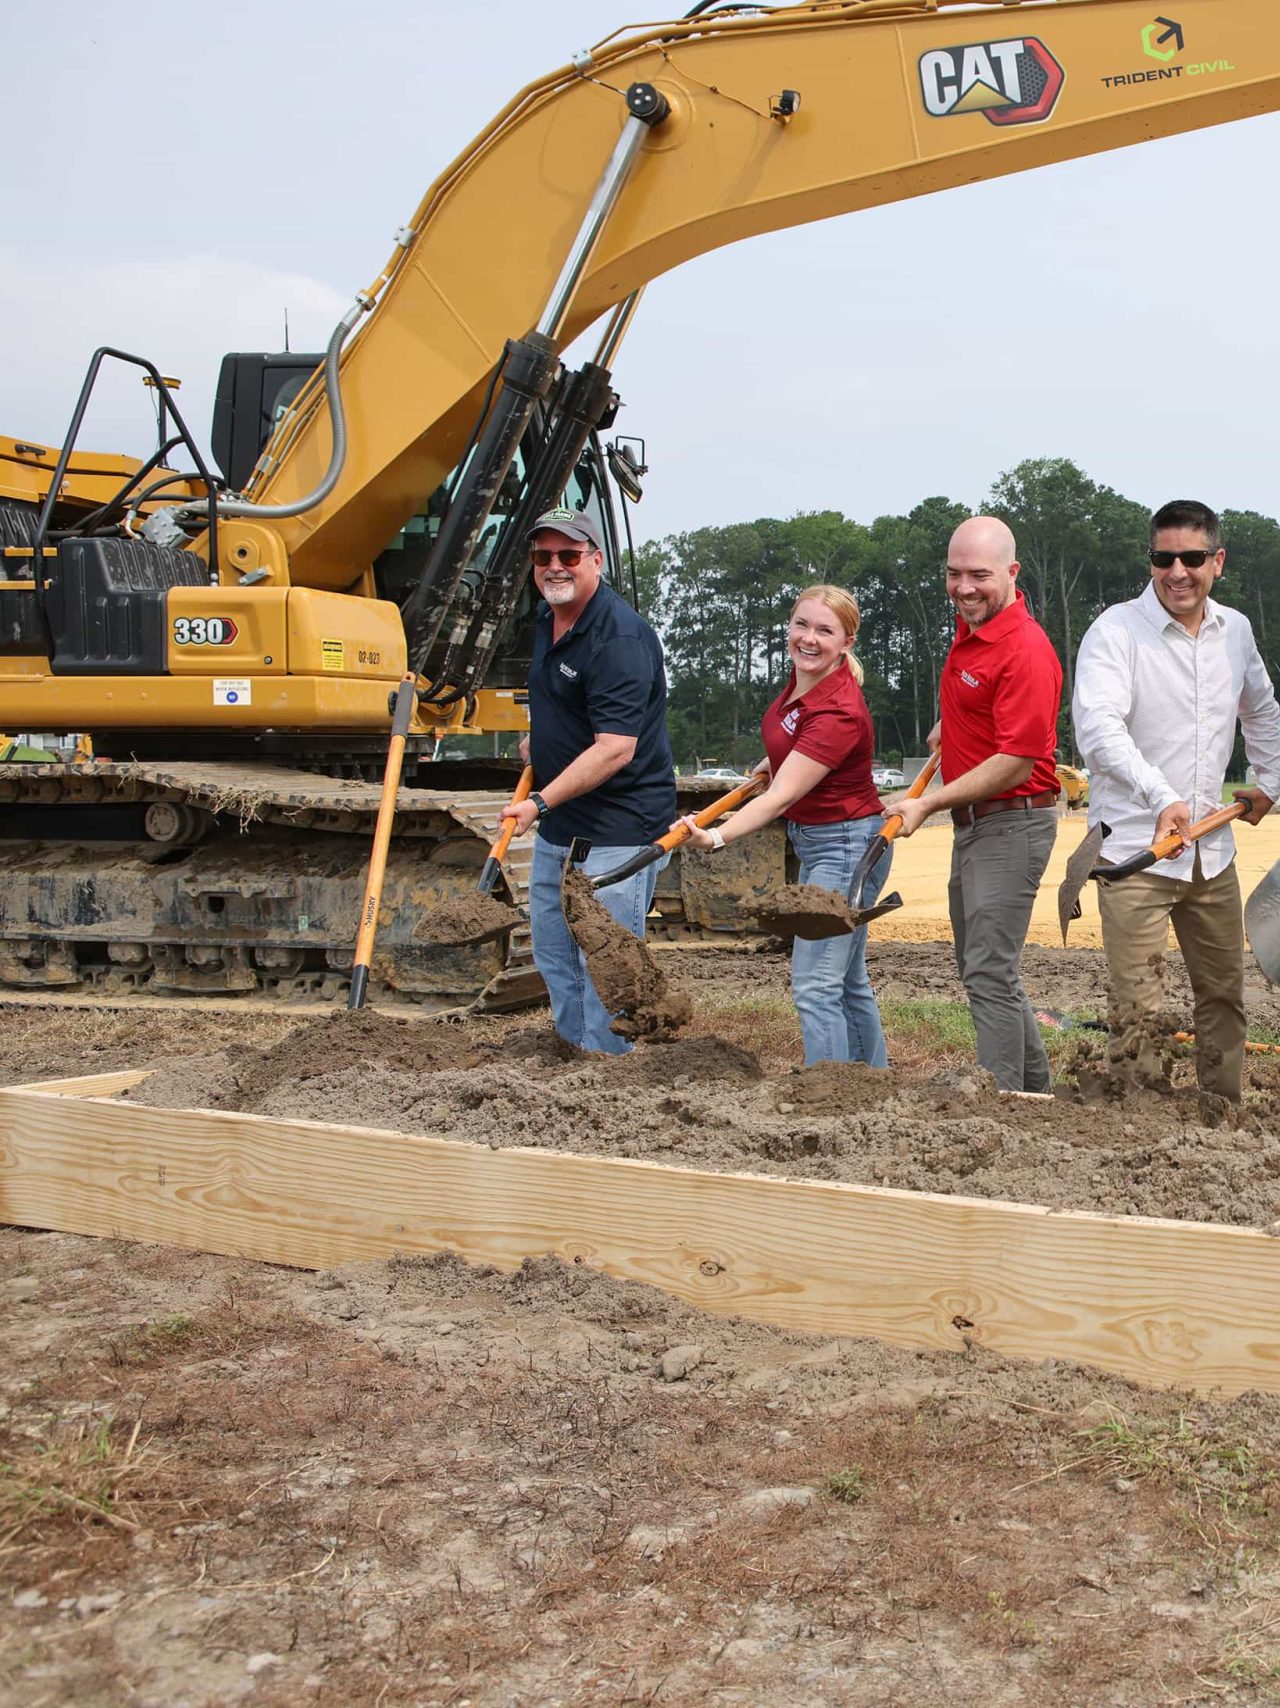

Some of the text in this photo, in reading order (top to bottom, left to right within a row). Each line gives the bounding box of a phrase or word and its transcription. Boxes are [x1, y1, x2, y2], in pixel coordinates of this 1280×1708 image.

[920, 39, 1024, 114] CAT
[1101, 60, 1235, 88] TRIDENT CIVIL
[174, 618, 223, 644] 330
[366, 896, 376, 920] HUSKY
